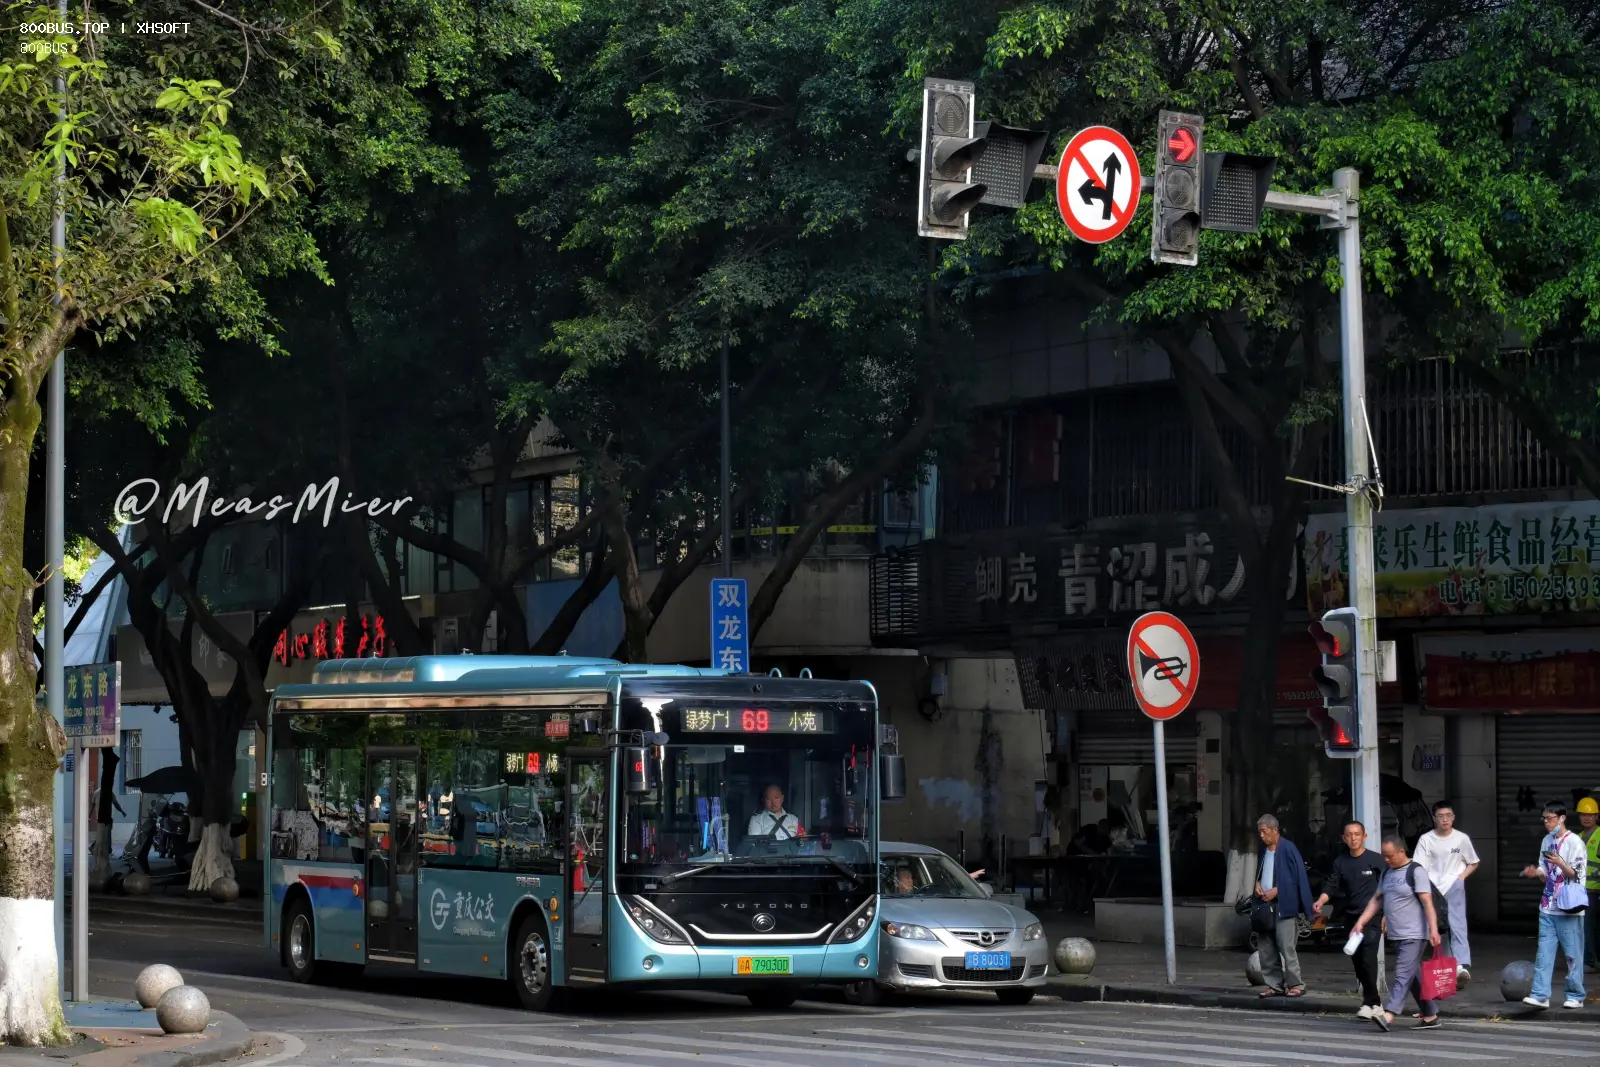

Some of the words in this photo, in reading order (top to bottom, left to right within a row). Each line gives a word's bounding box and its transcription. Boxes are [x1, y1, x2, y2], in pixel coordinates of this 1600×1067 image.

[717, 584, 743, 671] 双龙东
[742, 709, 769, 732] 69
[788, 711, 817, 732] 小苑
[453, 891, 496, 923] 重庆公交
